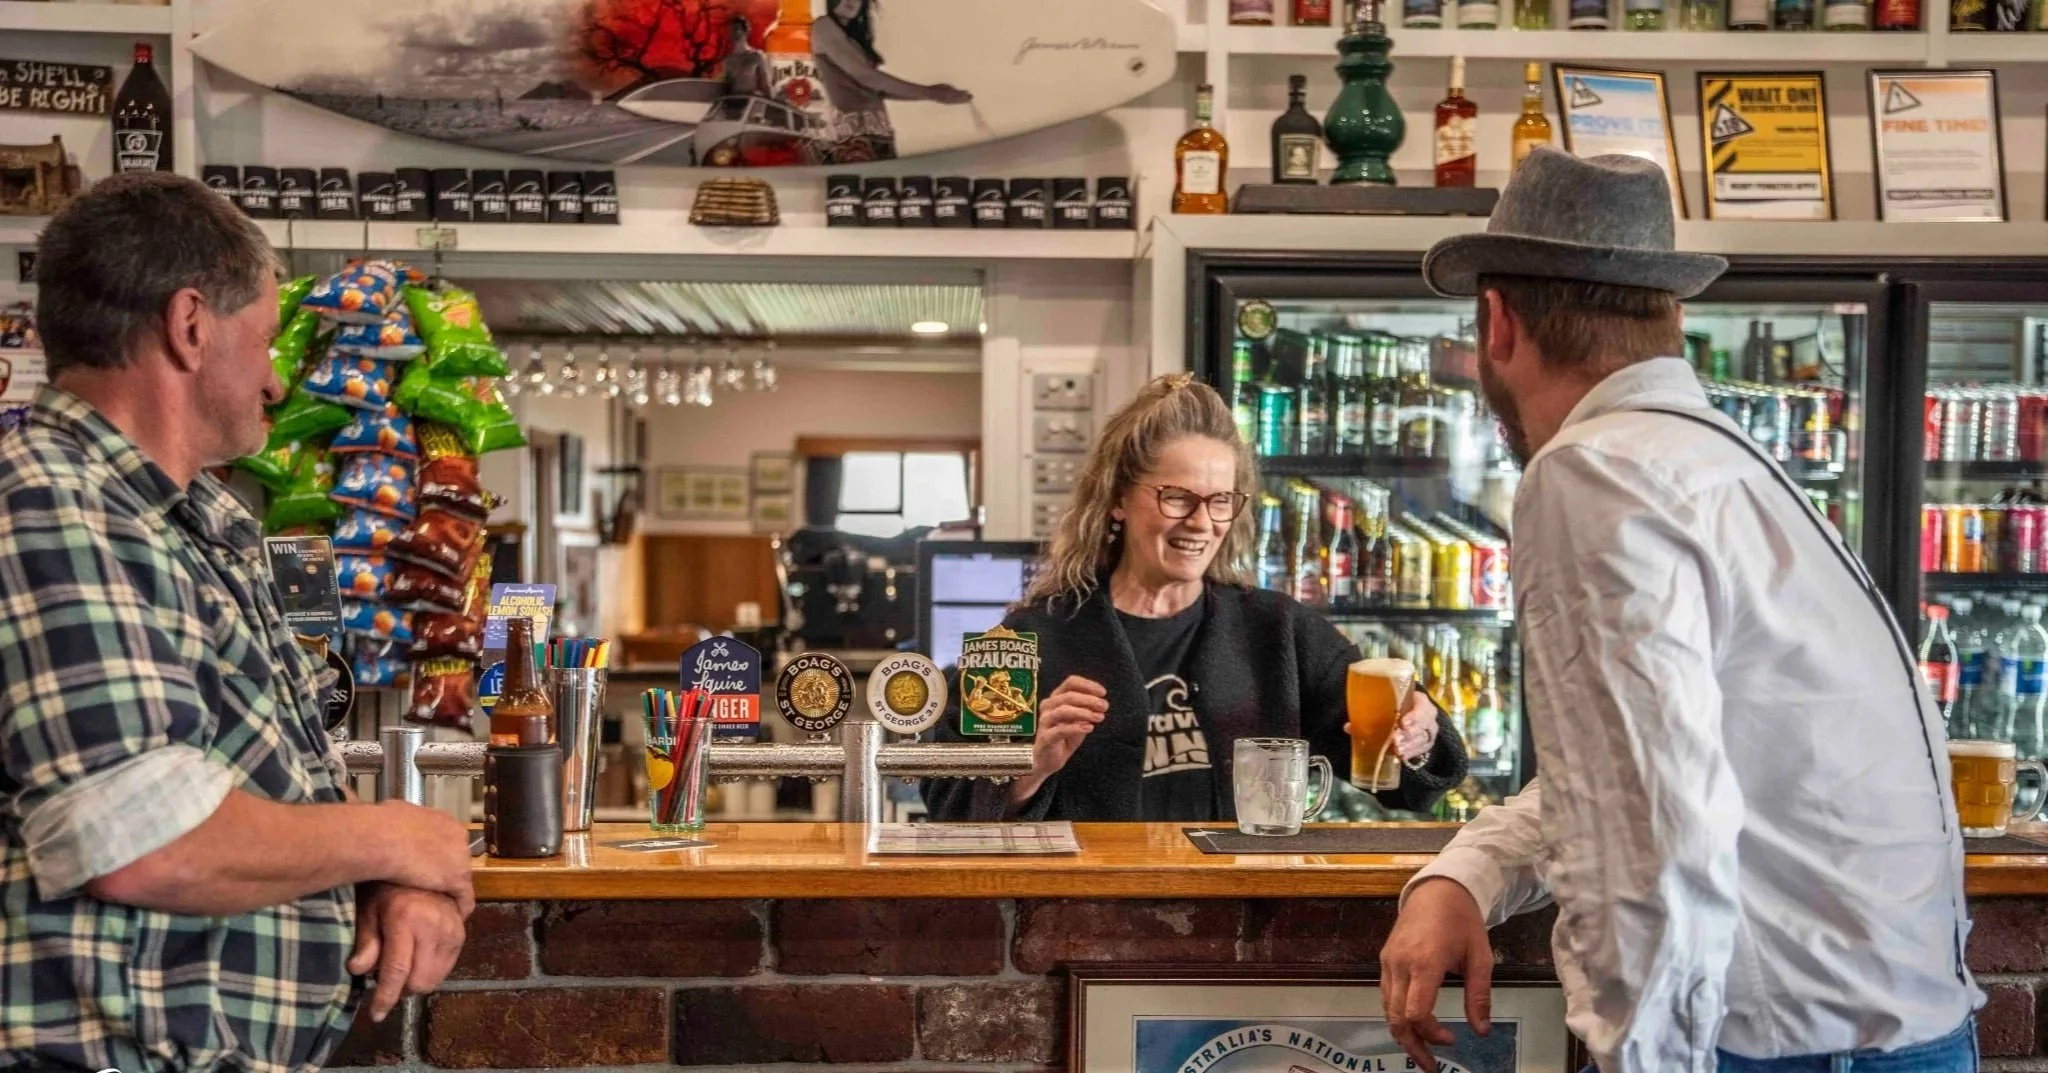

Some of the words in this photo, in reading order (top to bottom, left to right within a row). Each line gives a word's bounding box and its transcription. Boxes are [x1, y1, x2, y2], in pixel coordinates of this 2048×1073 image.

[794, 60, 820, 79] BEA
[1882, 119, 1929, 134] FINE
[271, 543, 298, 555] WIN
[500, 595, 545, 606] ALCOHOLIC
[488, 605, 517, 616] LEMON
[519, 606, 553, 617] SQUASH
[964, 641, 998, 655] JAMES
[1000, 640, 1037, 654] BOAG'S
[693, 649, 749, 674] James
[787, 656, 844, 679] BOAG'S
[881, 659, 933, 678] BOAG'S
[957, 651, 1042, 671] DRAUGHT
[692, 670, 748, 695] Squire
[779, 699, 796, 717] ST
[794, 701, 850, 730] GEORGE
[874, 700, 886, 714] ST
[884, 710, 926, 727] GEORGE
[925, 701, 939, 718] 3.5
[1288, 1031, 1386, 1072] NATIONAL
